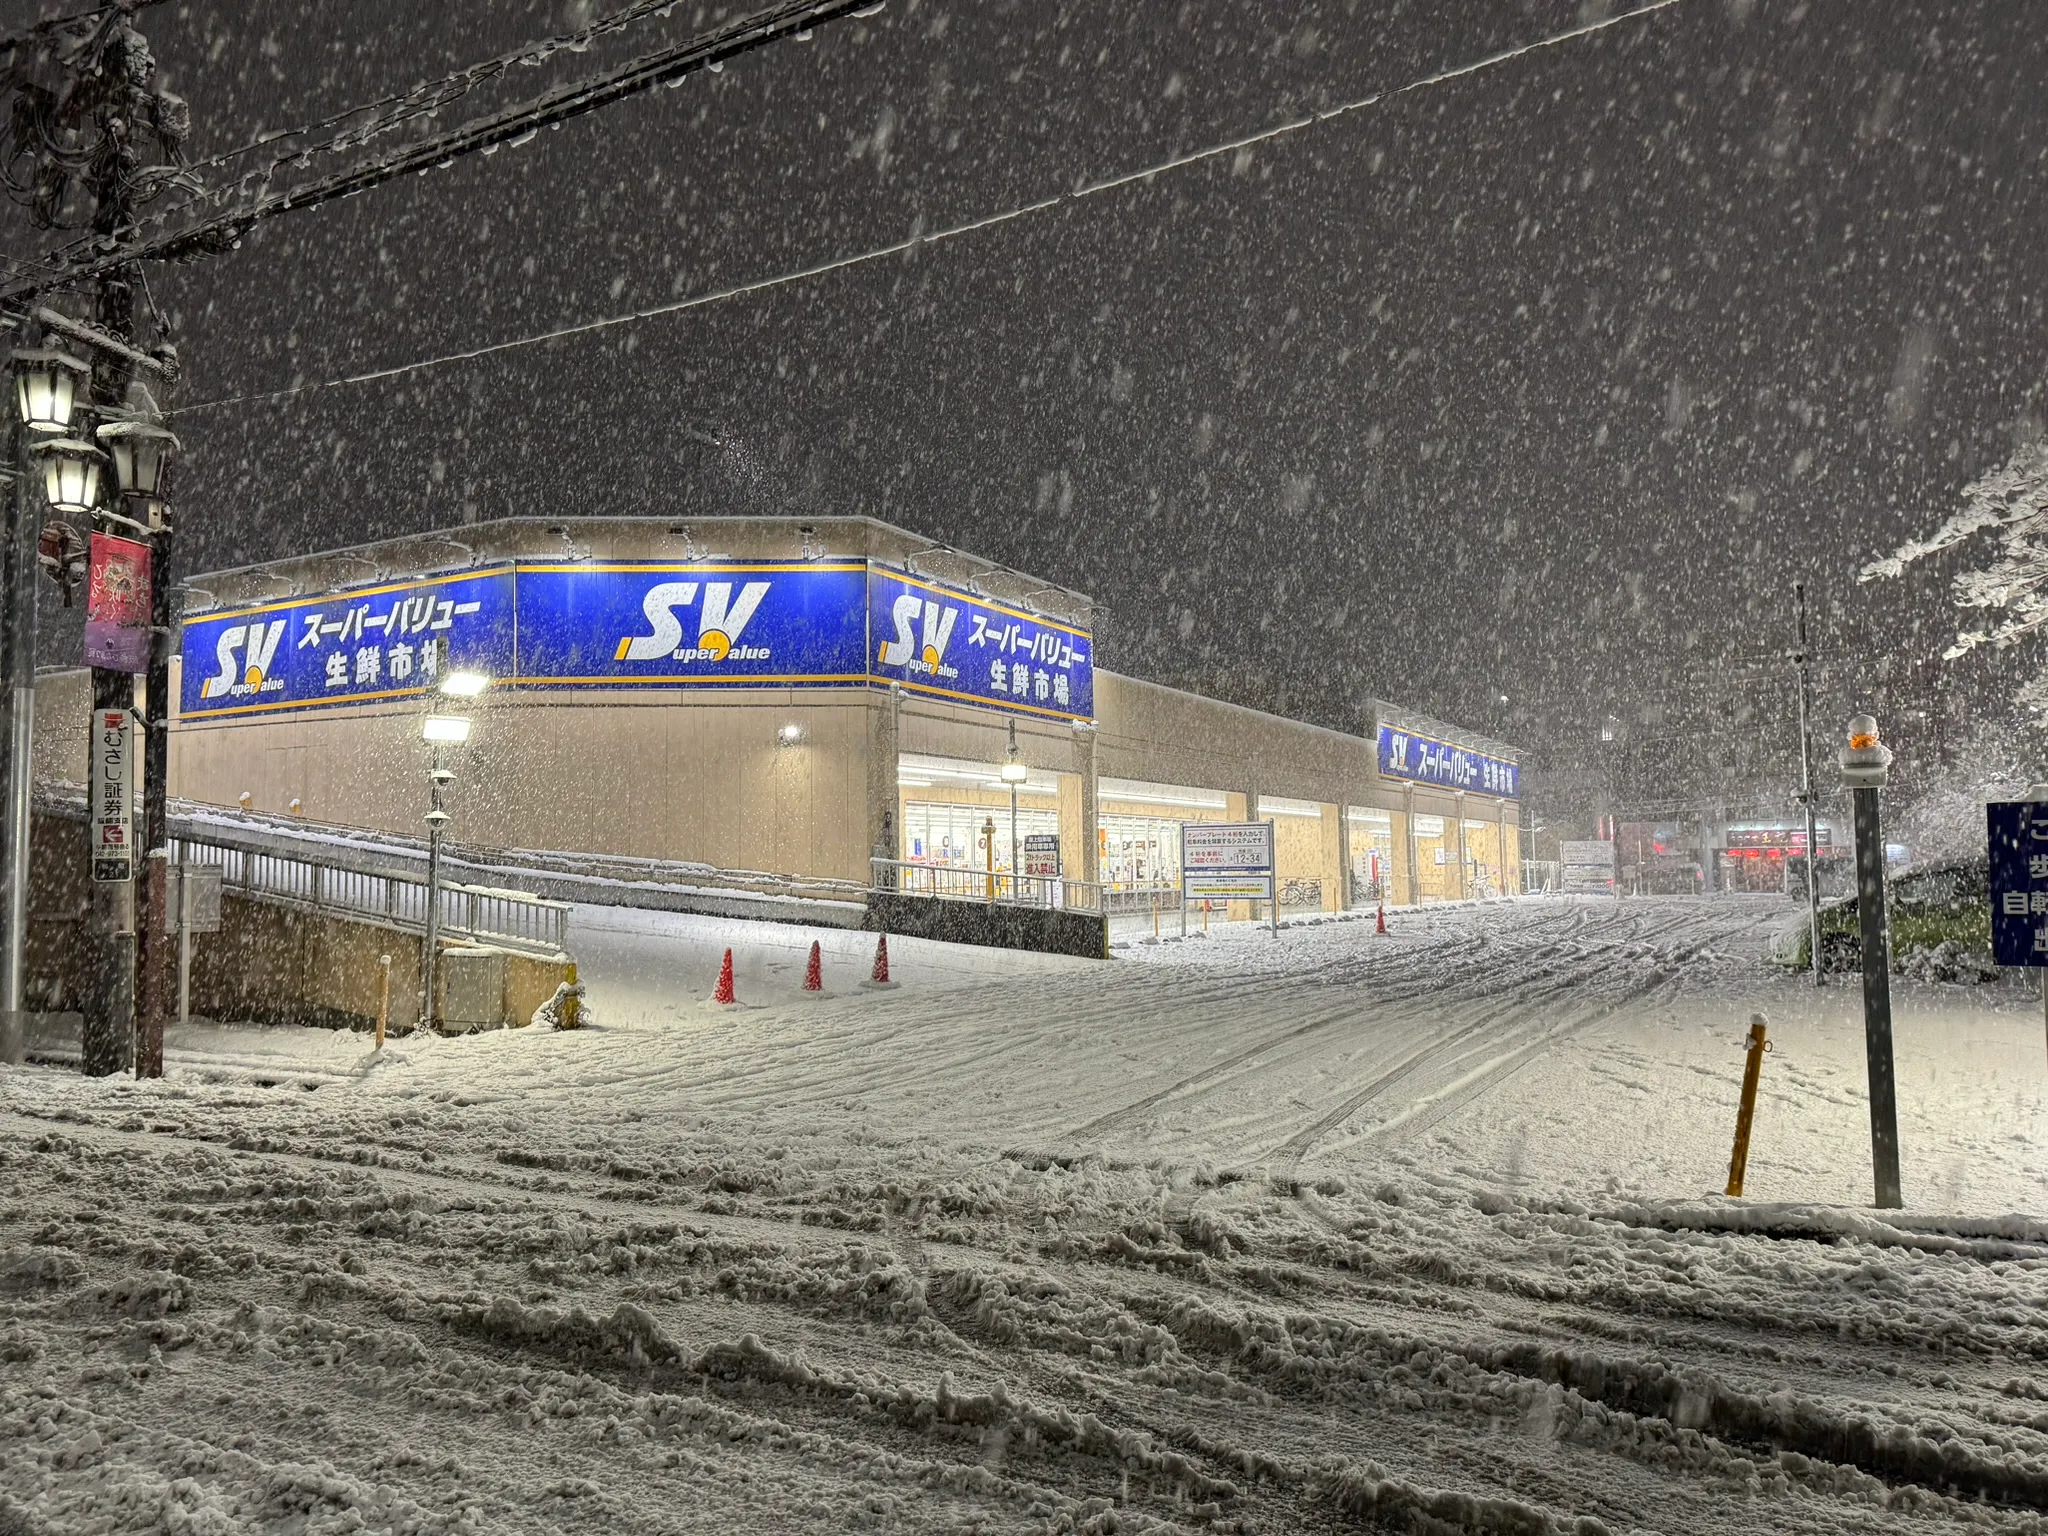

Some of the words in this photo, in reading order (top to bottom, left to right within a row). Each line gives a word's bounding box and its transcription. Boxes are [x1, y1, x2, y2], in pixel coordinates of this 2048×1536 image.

[298, 594, 481, 649] スーパーバリュー
[968, 614, 1086, 669] スーパーバリュー
[990, 658, 1069, 706] 生鮮市場
[103, 726, 128, 816] むさし証券
[1026, 862, 1055, 875] 進入禁止
[1236, 854, 1260, 864] 12-34
